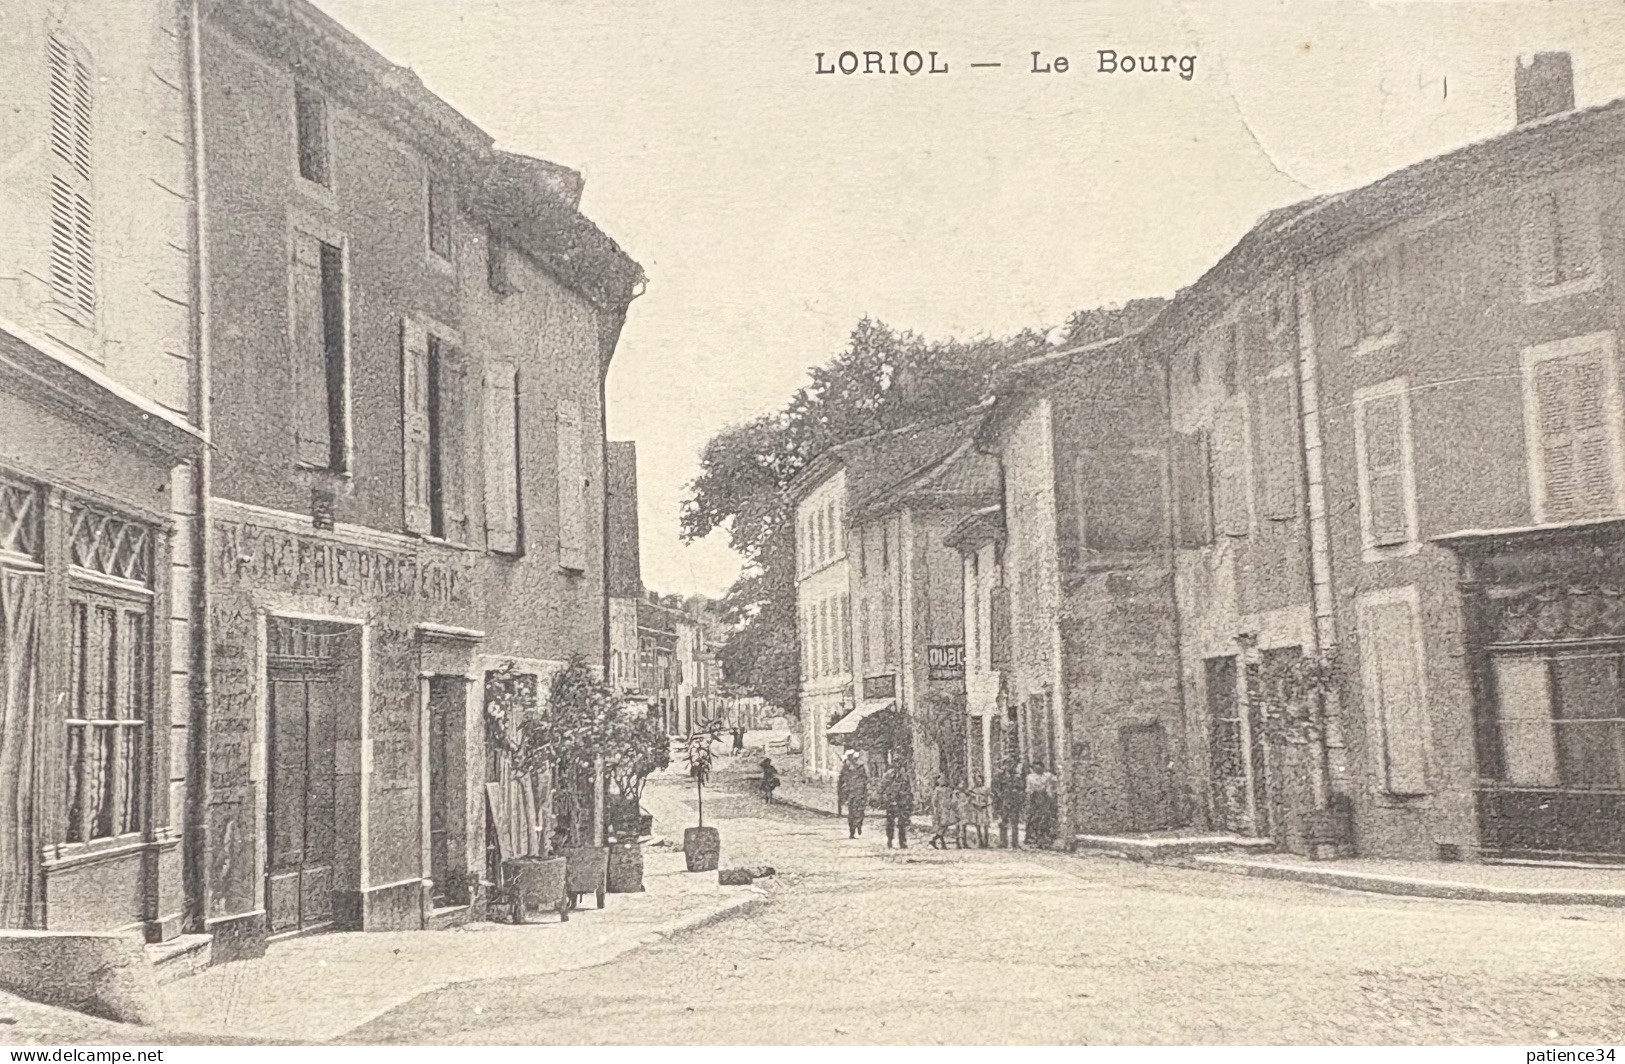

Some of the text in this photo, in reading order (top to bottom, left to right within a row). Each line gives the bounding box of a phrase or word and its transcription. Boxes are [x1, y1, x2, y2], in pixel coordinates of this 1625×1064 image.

[815, 50, 949, 76] LORIOL
[1030, 51, 1070, 74] Le
[1097, 49, 1197, 81] Bourg
